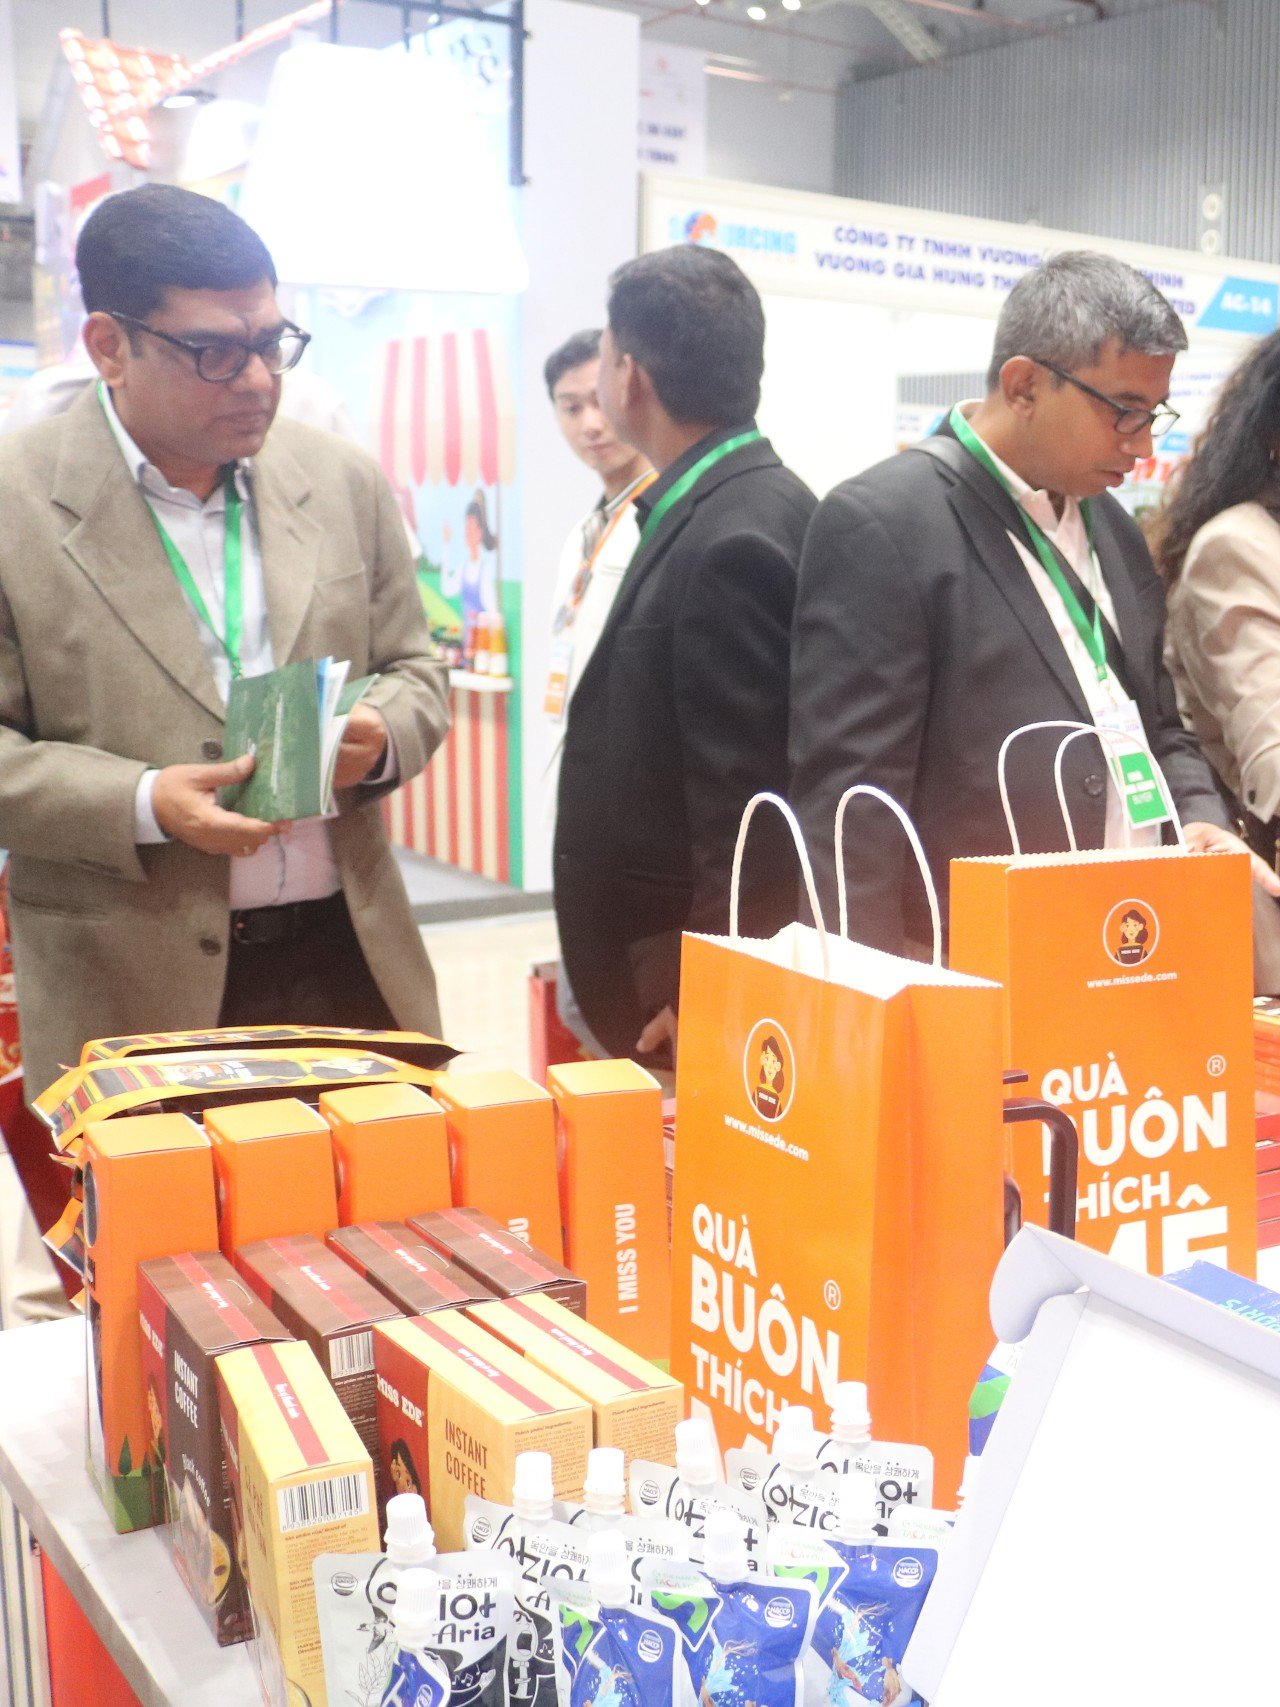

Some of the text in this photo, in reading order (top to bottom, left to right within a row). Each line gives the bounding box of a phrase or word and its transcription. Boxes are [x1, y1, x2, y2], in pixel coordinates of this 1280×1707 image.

[1086, 971, 1178, 989] www.missede.com
[1040, 1051, 1129, 1103] QUÀ
[724, 1113, 809, 1162] www.missede.com
[1042, 1170, 1170, 1224] HÍCH
[614, 1203, 639, 1315] I MISS YOU
[692, 1203, 757, 1277] QUÀ
[691, 1254, 840, 1409] BUÔN
[174, 1349, 199, 1400] INSTANT
[174, 1381, 199, 1429] COFFEE
[401, 1394, 424, 1429] EDE
[444, 1417, 488, 1470] INSTANT
[445, 1450, 487, 1500] COFFEE
[432, 1622, 496, 1645] Aria
